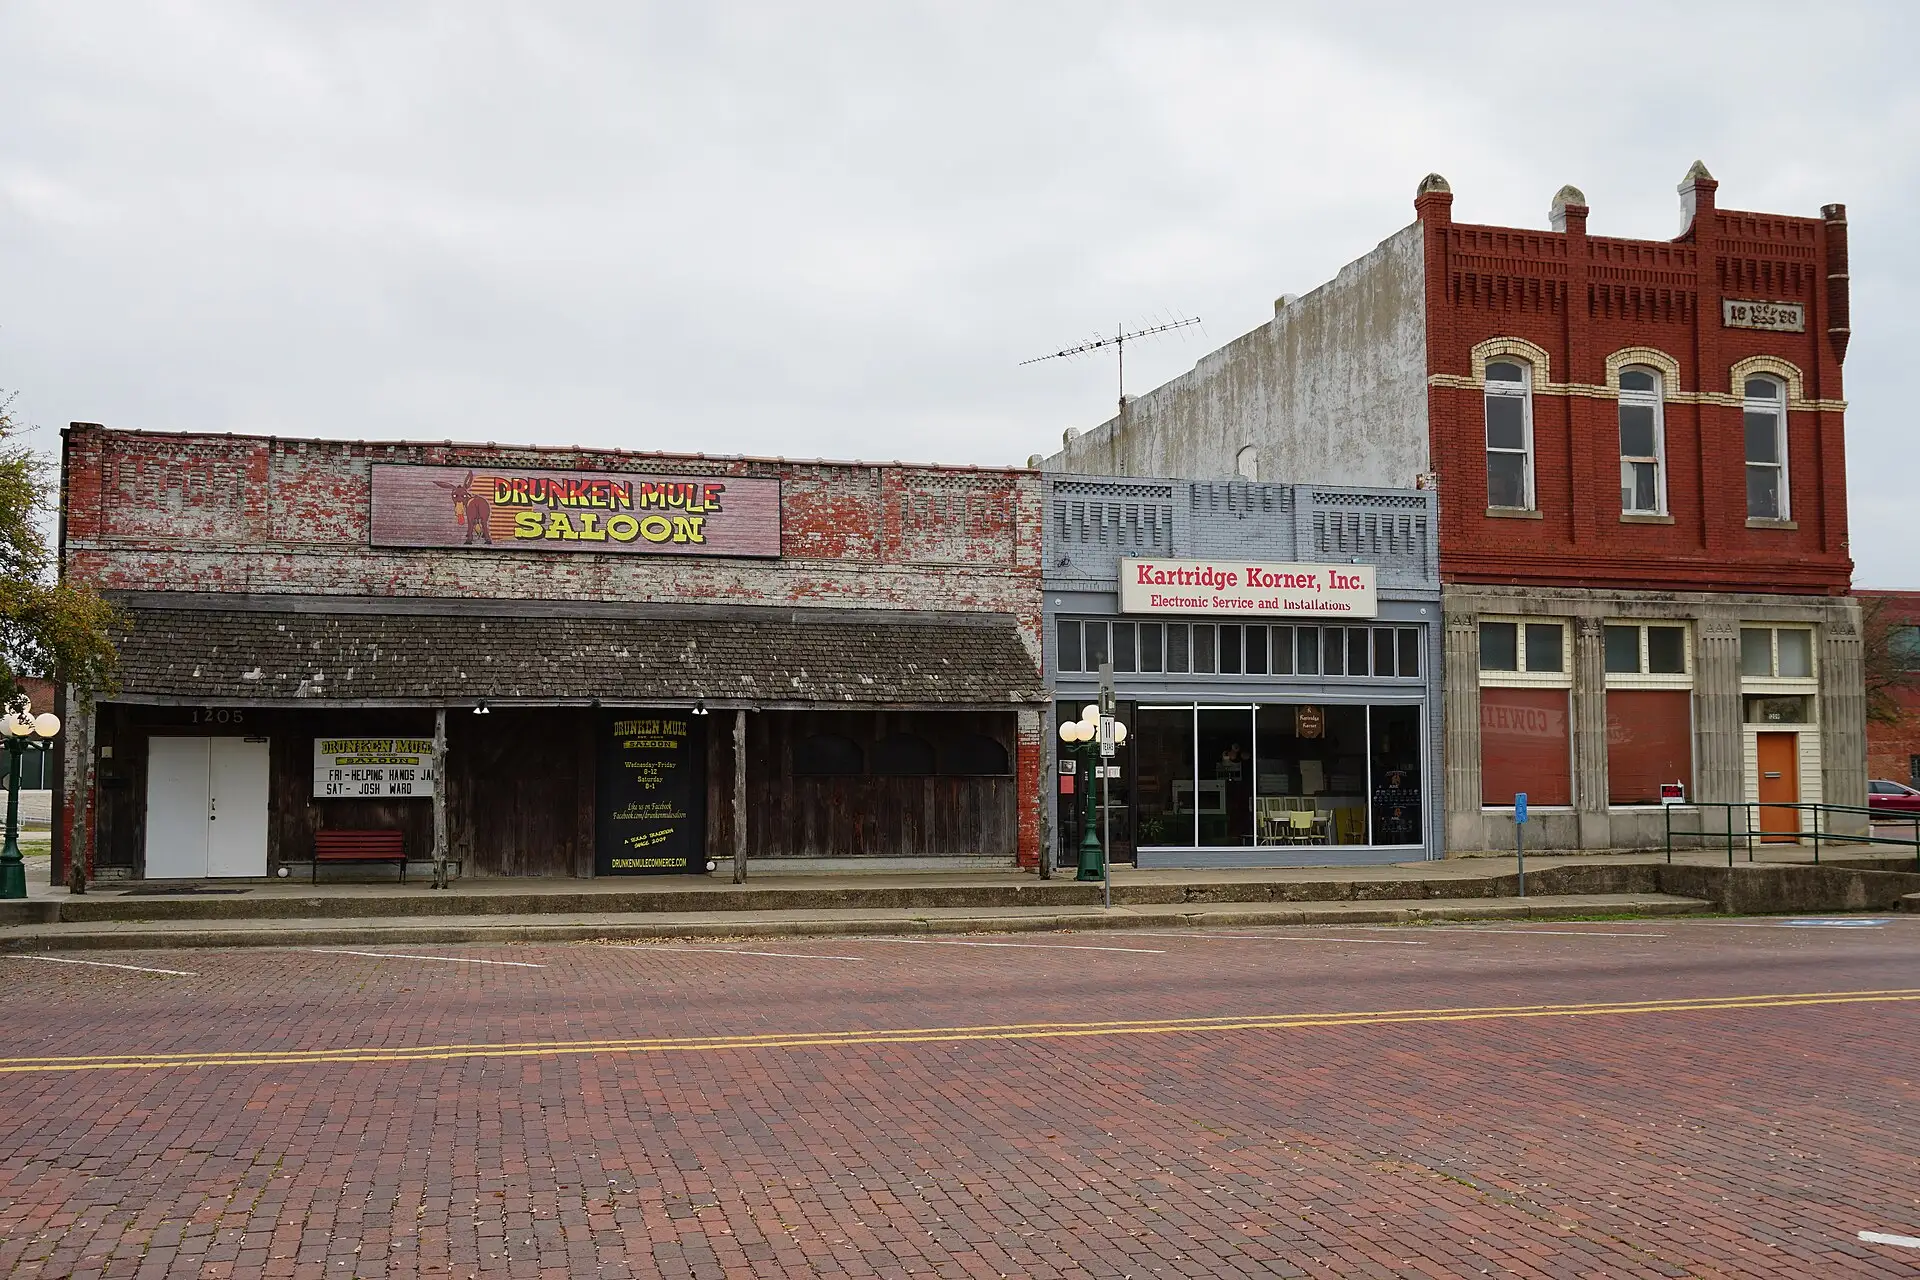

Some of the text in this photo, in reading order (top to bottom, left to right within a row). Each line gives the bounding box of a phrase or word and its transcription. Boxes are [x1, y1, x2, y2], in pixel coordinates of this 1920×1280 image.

[493, 477, 726, 513] DRUNKEN MULE
[513, 511, 707, 544] SALOON
[1136, 564, 1365, 592] Kartridge Korner, Inc.
[1150, 594, 1351, 611] Electronic Service and Installations
[191, 709, 244, 724] 1205
[613, 720, 687, 736] DRUNKEN MULE
[321, 740, 432, 755] DRUNKEN MULE
[345, 757, 409, 765] SALOON
[624, 761, 676, 769] Wednesday-Friday
[329, 769, 342, 781] FRI
[351, 769, 384, 781] HELPING
[389, 769, 415, 781] HANDS
[326, 783, 343, 795] SAT
[359, 783, 380, 795] JOSH
[389, 783, 412, 795] WARD
